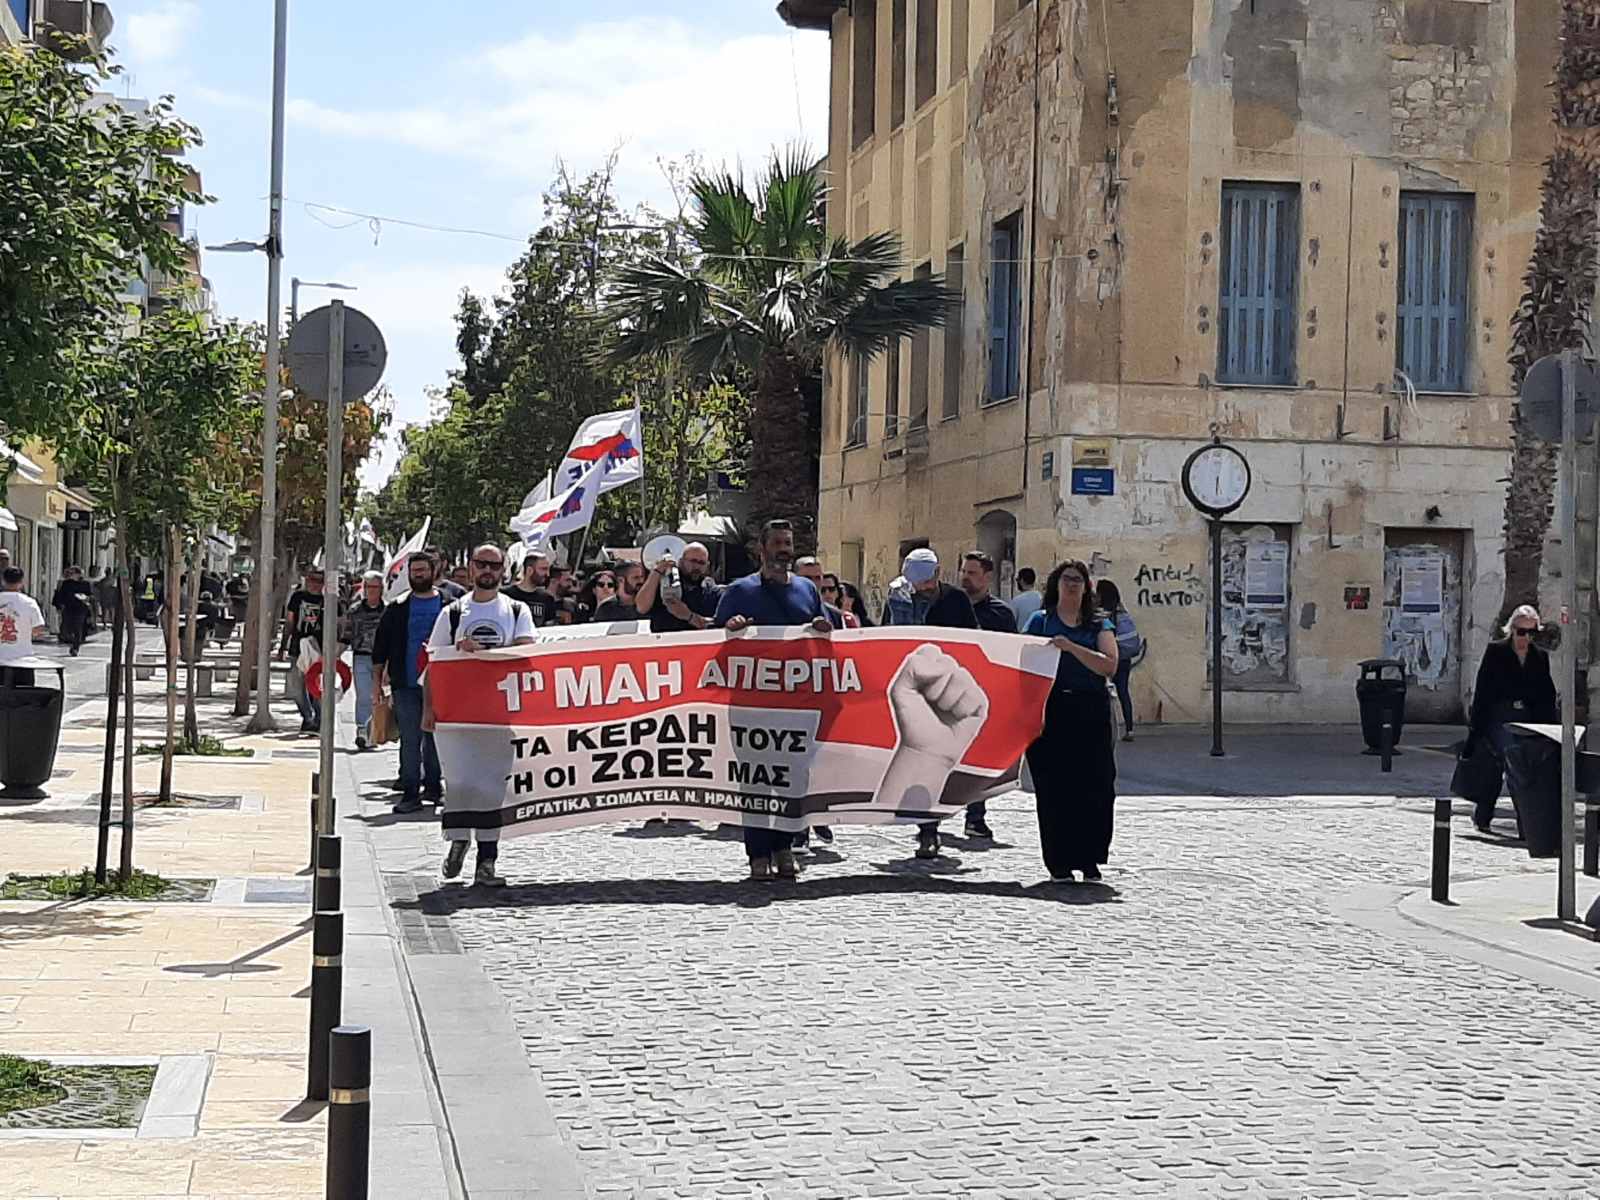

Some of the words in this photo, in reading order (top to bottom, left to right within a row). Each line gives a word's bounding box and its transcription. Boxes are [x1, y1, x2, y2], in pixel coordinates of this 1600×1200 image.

[496, 670, 544, 711] 1η
[554, 660, 682, 708] ΜΑΗ
[696, 656, 862, 693] ΑΠΕΡΓΙΑ
[510, 736, 551, 760] ΤΑ
[567, 713, 717, 752] ΚΕΡΔΗ
[730, 725, 807, 753] ΤΟΥΣ
[544, 766, 576, 789] ΟΙ
[591, 749, 714, 784] ΖΩΕΣ
[728, 761, 790, 788] ΜΑΣ
[516, 797, 591, 819] ΕΡΓΑΤΙΚΑ
[596, 789, 680, 807] ΣΩΜΑΤΕΙΑ
[704, 791, 789, 813] ΗΡΑΚΛΕΙΟΥ
